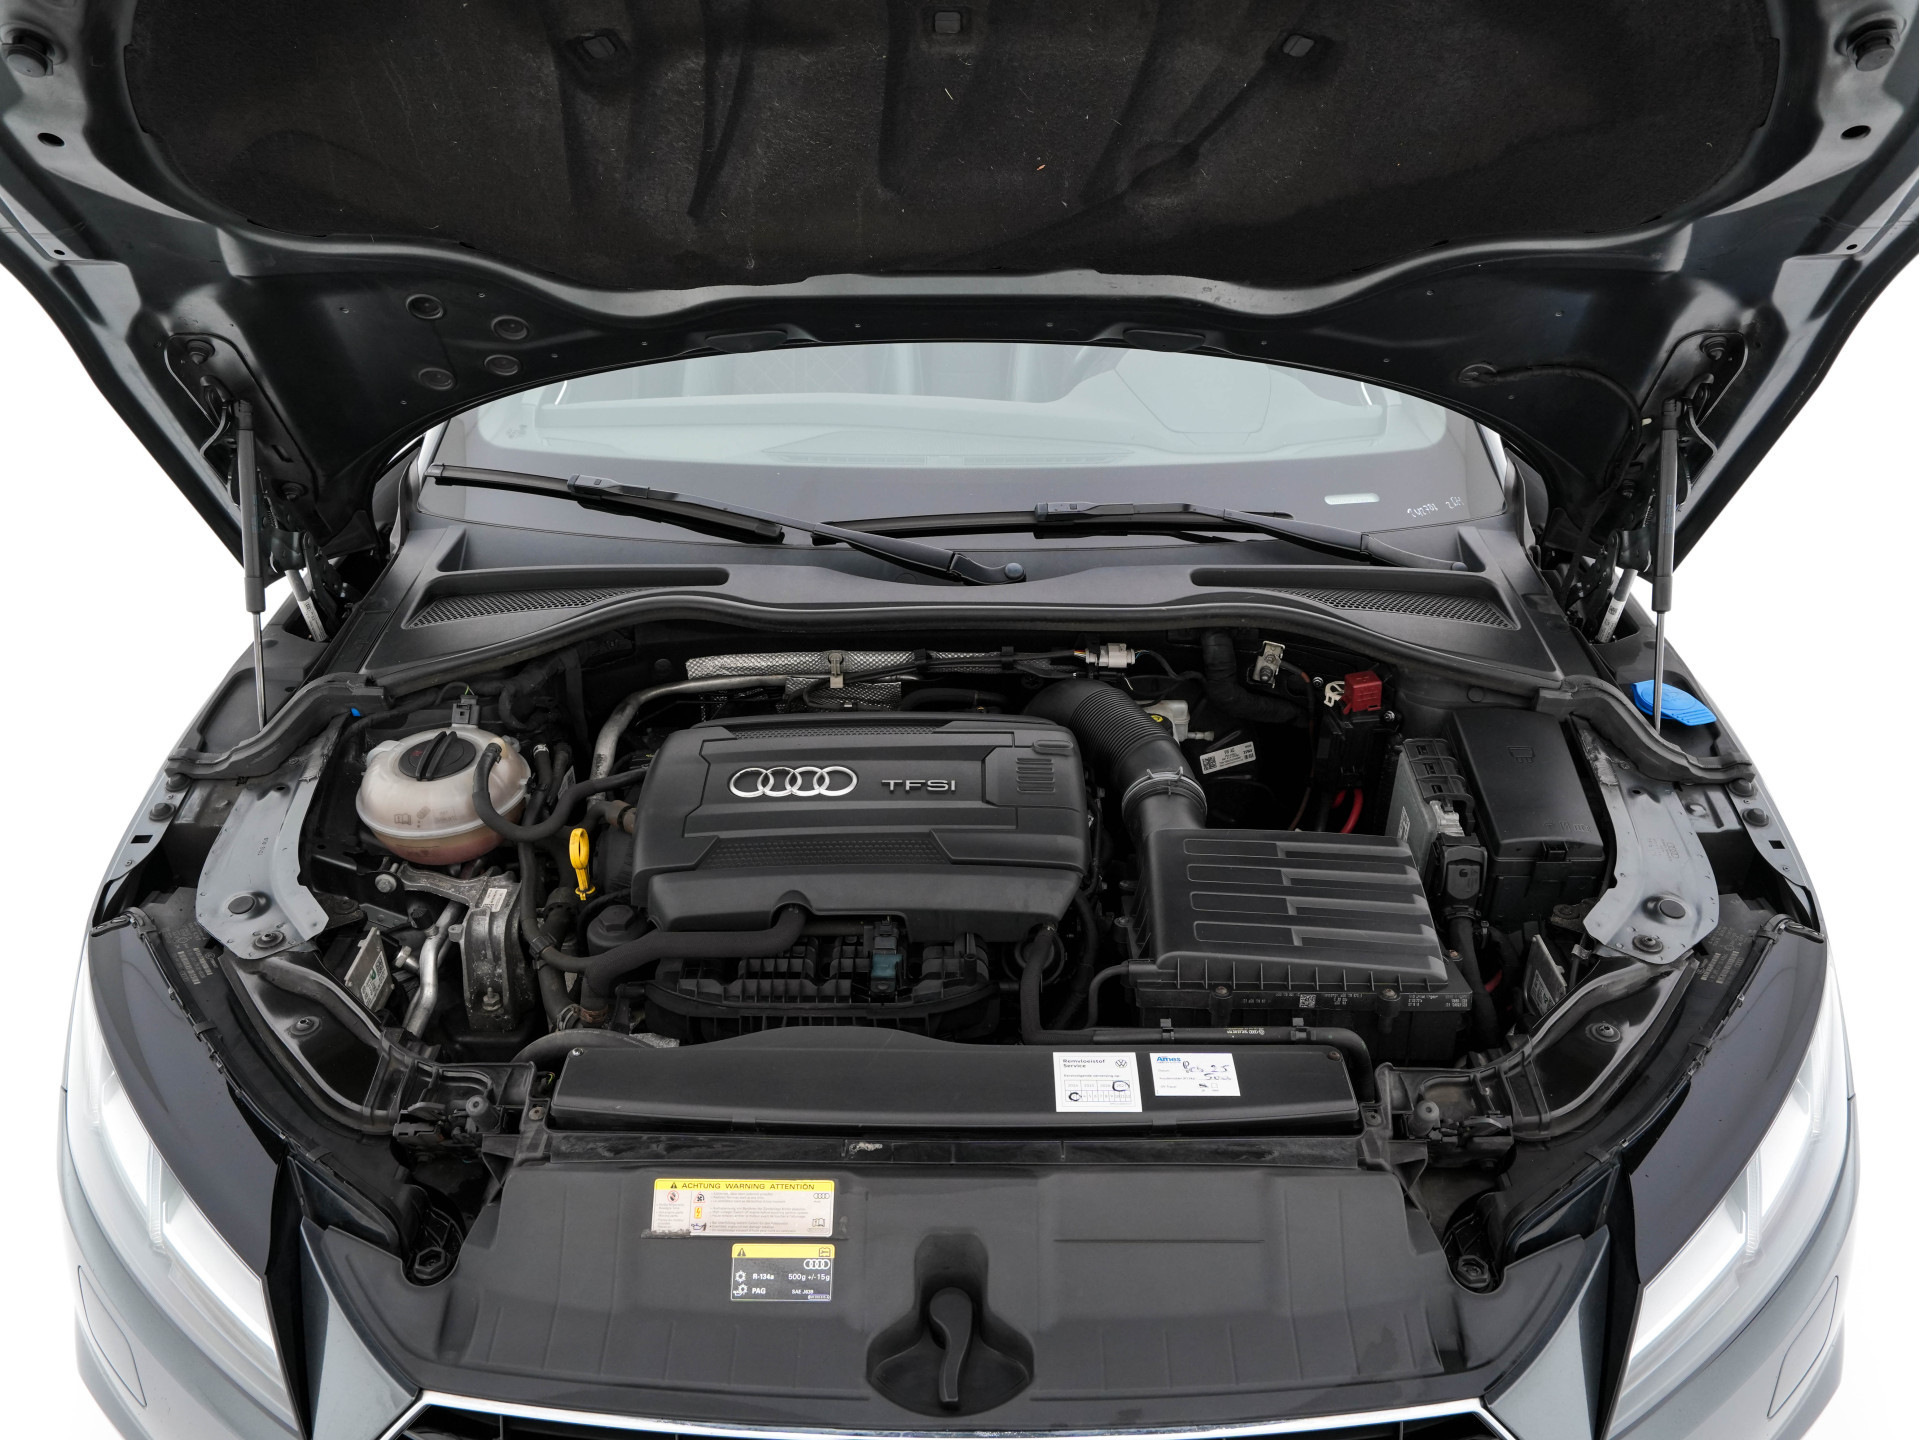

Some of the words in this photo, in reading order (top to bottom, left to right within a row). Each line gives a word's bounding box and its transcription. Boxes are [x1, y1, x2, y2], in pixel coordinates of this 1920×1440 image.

[881, 779, 957, 792] TFSI
[788, 1273, 806, 1282] 500g
[751, 1287, 766, 1295] PAG
